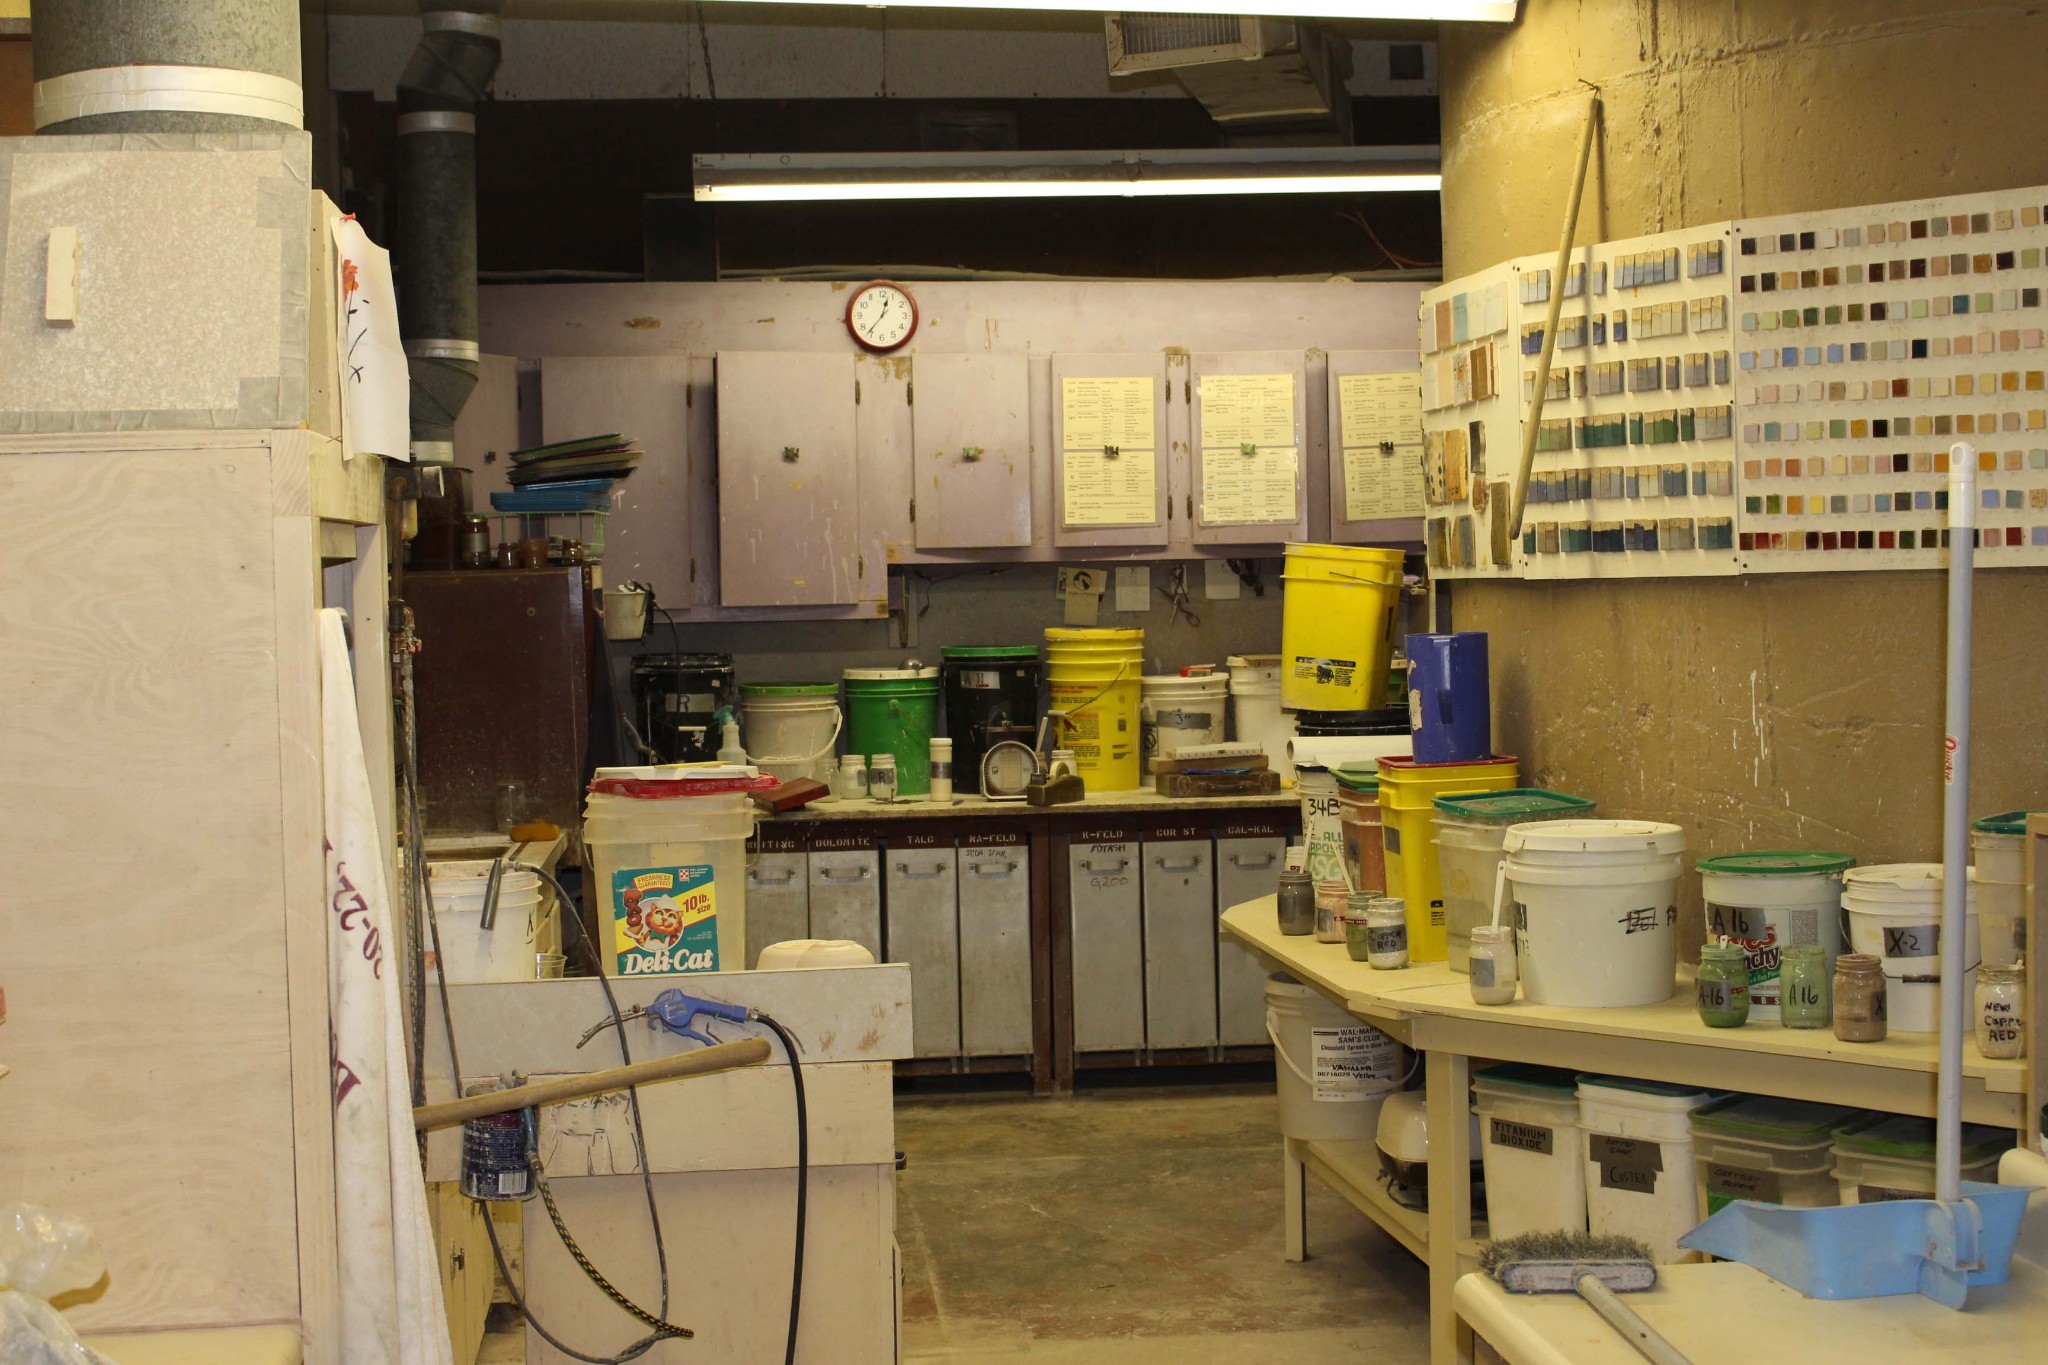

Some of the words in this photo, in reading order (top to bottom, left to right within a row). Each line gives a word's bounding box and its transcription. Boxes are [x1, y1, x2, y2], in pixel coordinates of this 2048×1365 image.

[868, 293, 873, 301] 11
[879, 290, 887, 298] 12
[860, 301, 868, 309] 10
[898, 300, 905, 308] 2
[856, 312, 863, 320] 9
[902, 312, 908, 320] 3
[860, 323, 866, 331] 8
[890, 331, 897, 339] 5
[1183, 827, 1197, 836] ST
[815, 837, 871, 849] DOLOMITE
[968, 833, 1017, 844] NA-FELD
[637, 874, 672, 884] FRESHNESS
[682, 895, 698, 913] 10
[698, 893, 710, 904] lb.
[696, 903, 711, 915] size
[623, 948, 714, 975] Deli-Cat
[1988, 1030, 2017, 1043] RED
[1492, 1120, 1547, 1142] TITANIUM
[1500, 1132, 1542, 1151] DIOXIDE
